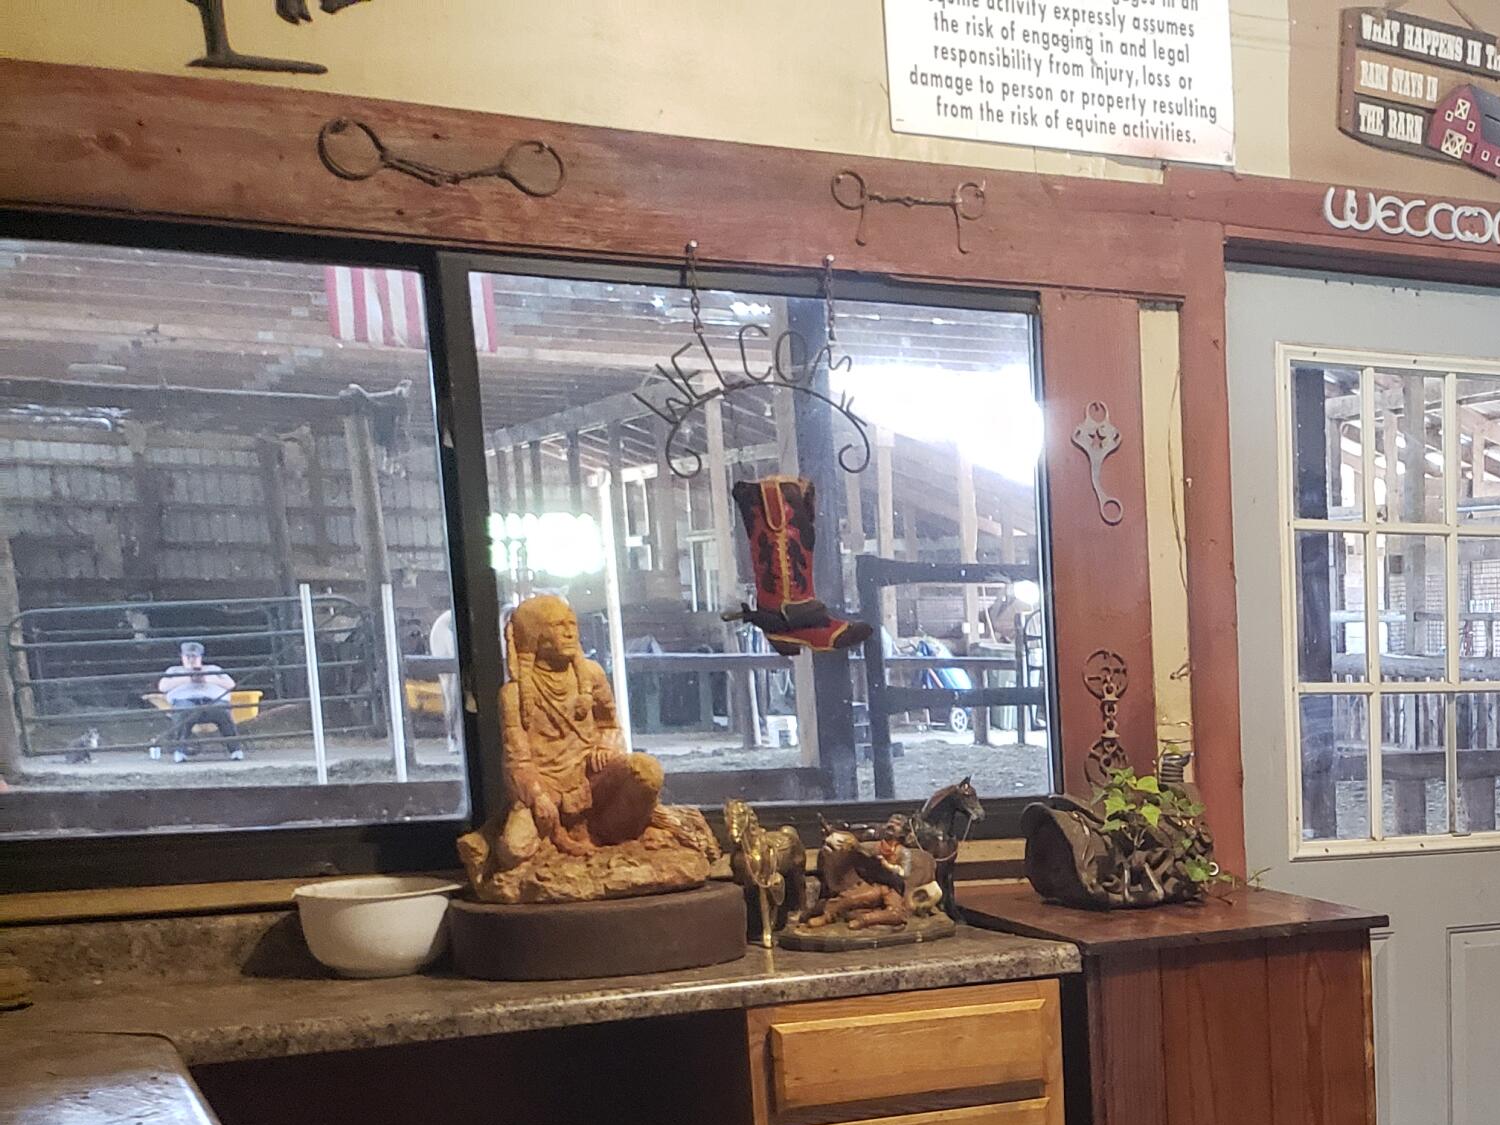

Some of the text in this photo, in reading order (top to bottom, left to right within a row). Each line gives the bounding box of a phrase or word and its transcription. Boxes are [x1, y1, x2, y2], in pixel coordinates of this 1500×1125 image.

[934, 11, 1190, 65] the risk of engaging in and legal
[987, 0, 1046, 22] activity
[1054, 6, 1125, 33] expressly
[1133, 16, 1194, 37] assumes
[1361, 13, 1400, 47] WHAT
[1403, 23, 1464, 62] HAPPENS
[1466, 39, 1482, 67] IN
[934, 45, 1193, 91] responsibility from injury, loss or
[1360, 60, 1438, 103] BARN STAYS IN
[910, 64, 1217, 124] damage to person or property resulting
[936, 96, 1196, 145] from the risk of equine activities.
[1359, 102, 1424, 145] THE BARN
